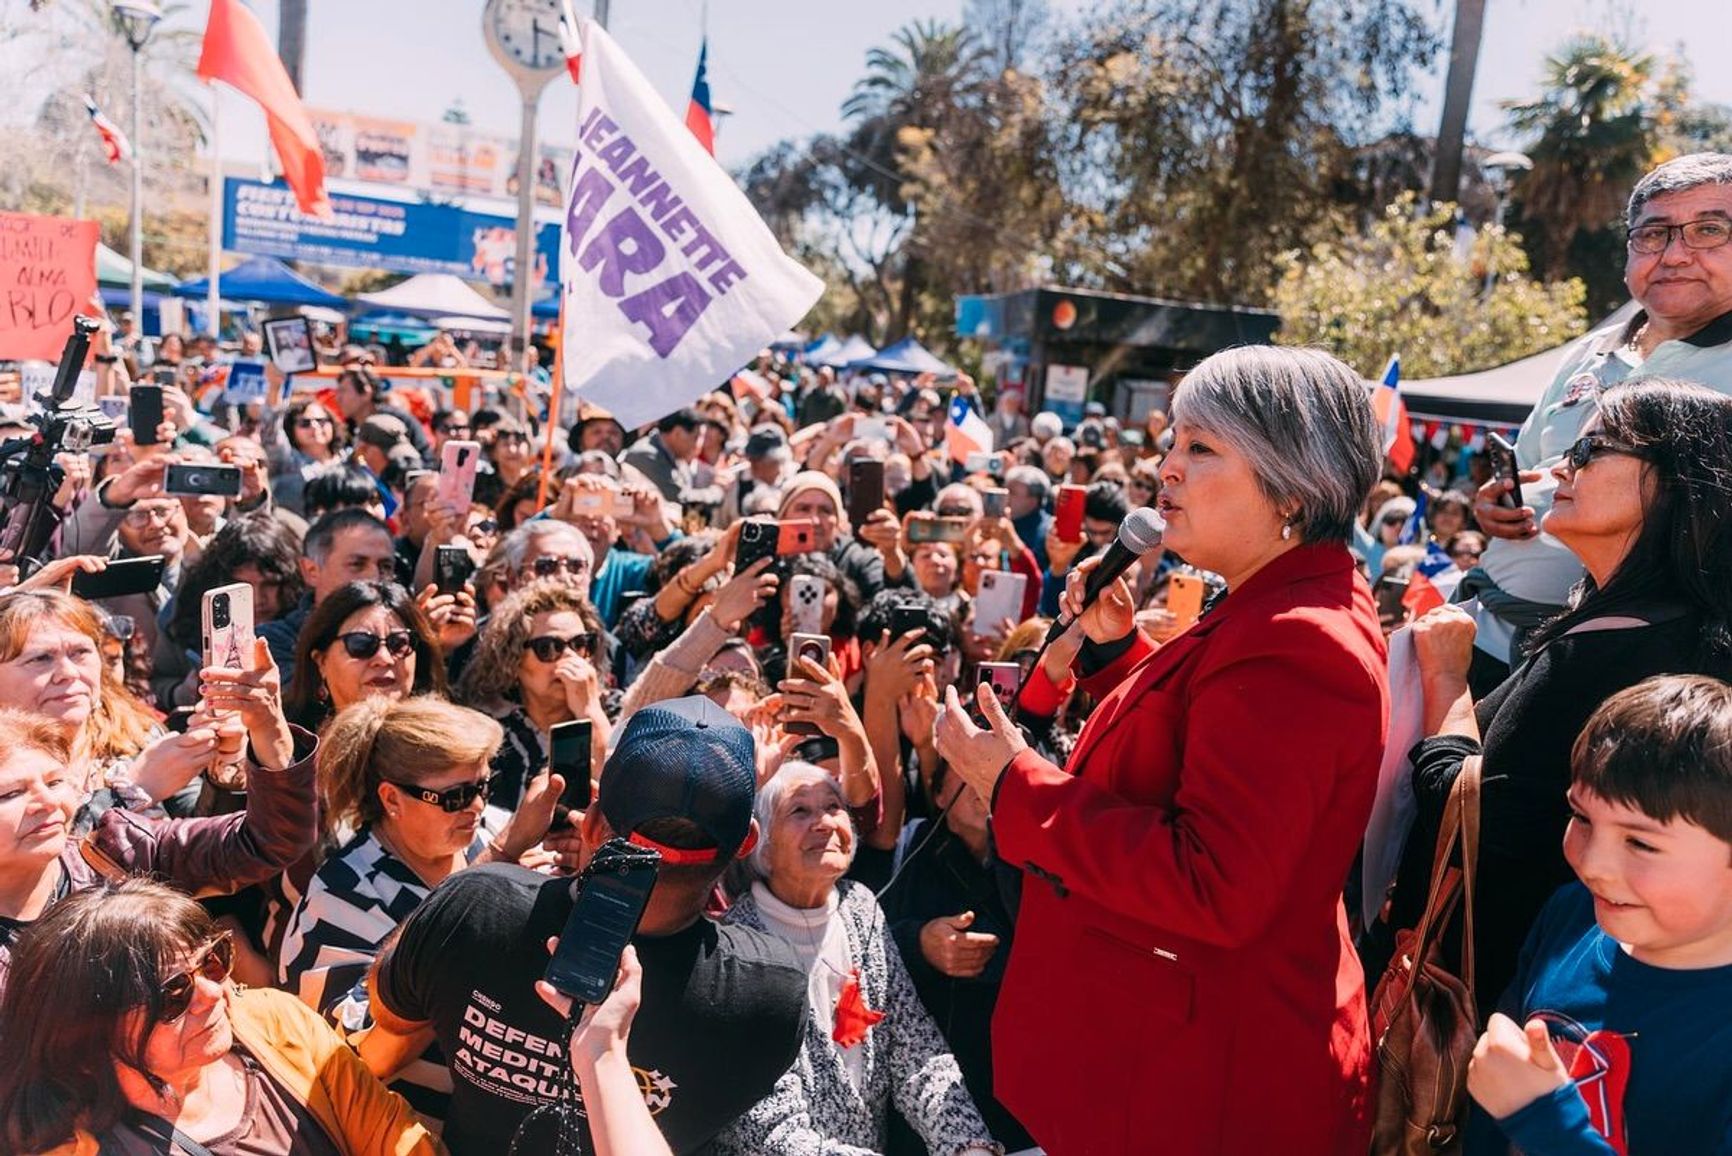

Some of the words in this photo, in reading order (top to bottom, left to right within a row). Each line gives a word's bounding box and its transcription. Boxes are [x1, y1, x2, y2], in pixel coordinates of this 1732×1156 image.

[567, 150, 714, 360] ARA
[579, 106, 748, 296] JEANNETTE
[459, 1026, 560, 1078] MEDIT
[463, 1004, 562, 1059] DEFEN
